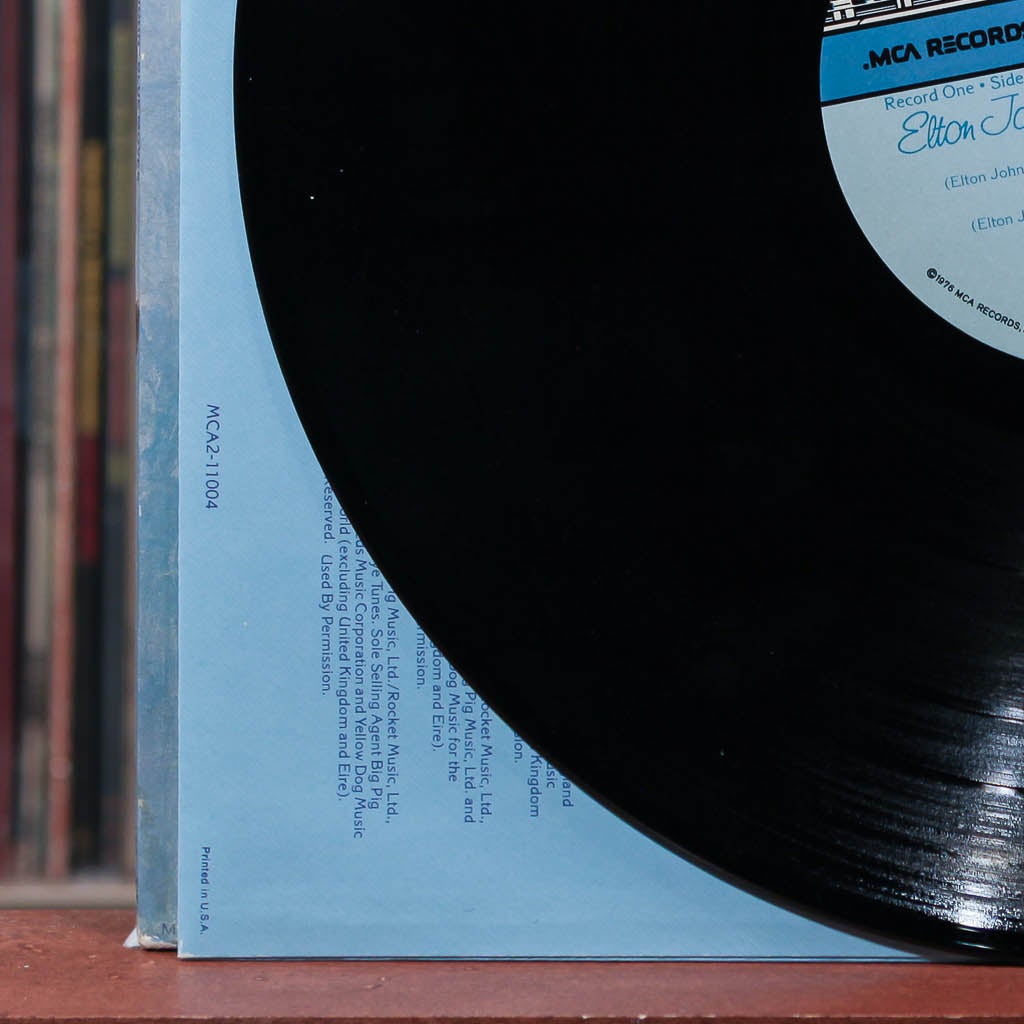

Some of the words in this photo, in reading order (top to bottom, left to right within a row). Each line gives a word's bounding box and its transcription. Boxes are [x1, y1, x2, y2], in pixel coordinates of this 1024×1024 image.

[884, 87, 938, 110] Record
[942, 84, 973, 98] One
[990, 72, 1023, 89] Side
[897, 110, 976, 154] Elton
[944, 174, 986, 190] (Elton
[971, 216, 1012, 231] (Elton
[954, 289, 974, 307] MCA
[976, 303, 1022, 332] RECORDS,
[206, 404, 220, 509] MCA2-11004
[336, 540, 350, 611] (excluding
[355, 559, 366, 599] Music
[371, 582, 383, 623] Tunes.
[339, 617, 350, 661] United
[352, 603, 366, 684] Corporation
[371, 629, 383, 658] Sole
[386, 608, 399, 651] Music,
[336, 667, 350, 728] Kingdom
[354, 688, 366, 713] and
[368, 664, 383, 709] Selling
[386, 657, 399, 738] Ltd./Rocket
[339, 734, 350, 758] and
[354, 718, 366, 760] Yellow
[368, 715, 383, 756] Agent
[336, 764, 350, 801] Eire).
[351, 765, 365, 792] Dog
[368, 761, 382, 782] Big
[386, 744, 399, 788] Music,
[354, 798, 365, 838] Music
[368, 788, 382, 809] Pig
[386, 793, 399, 824] Ltd.,
[201, 846, 210, 884] Printed
[201, 888, 209, 898] in
[200, 902, 210, 935] U.S.A.
